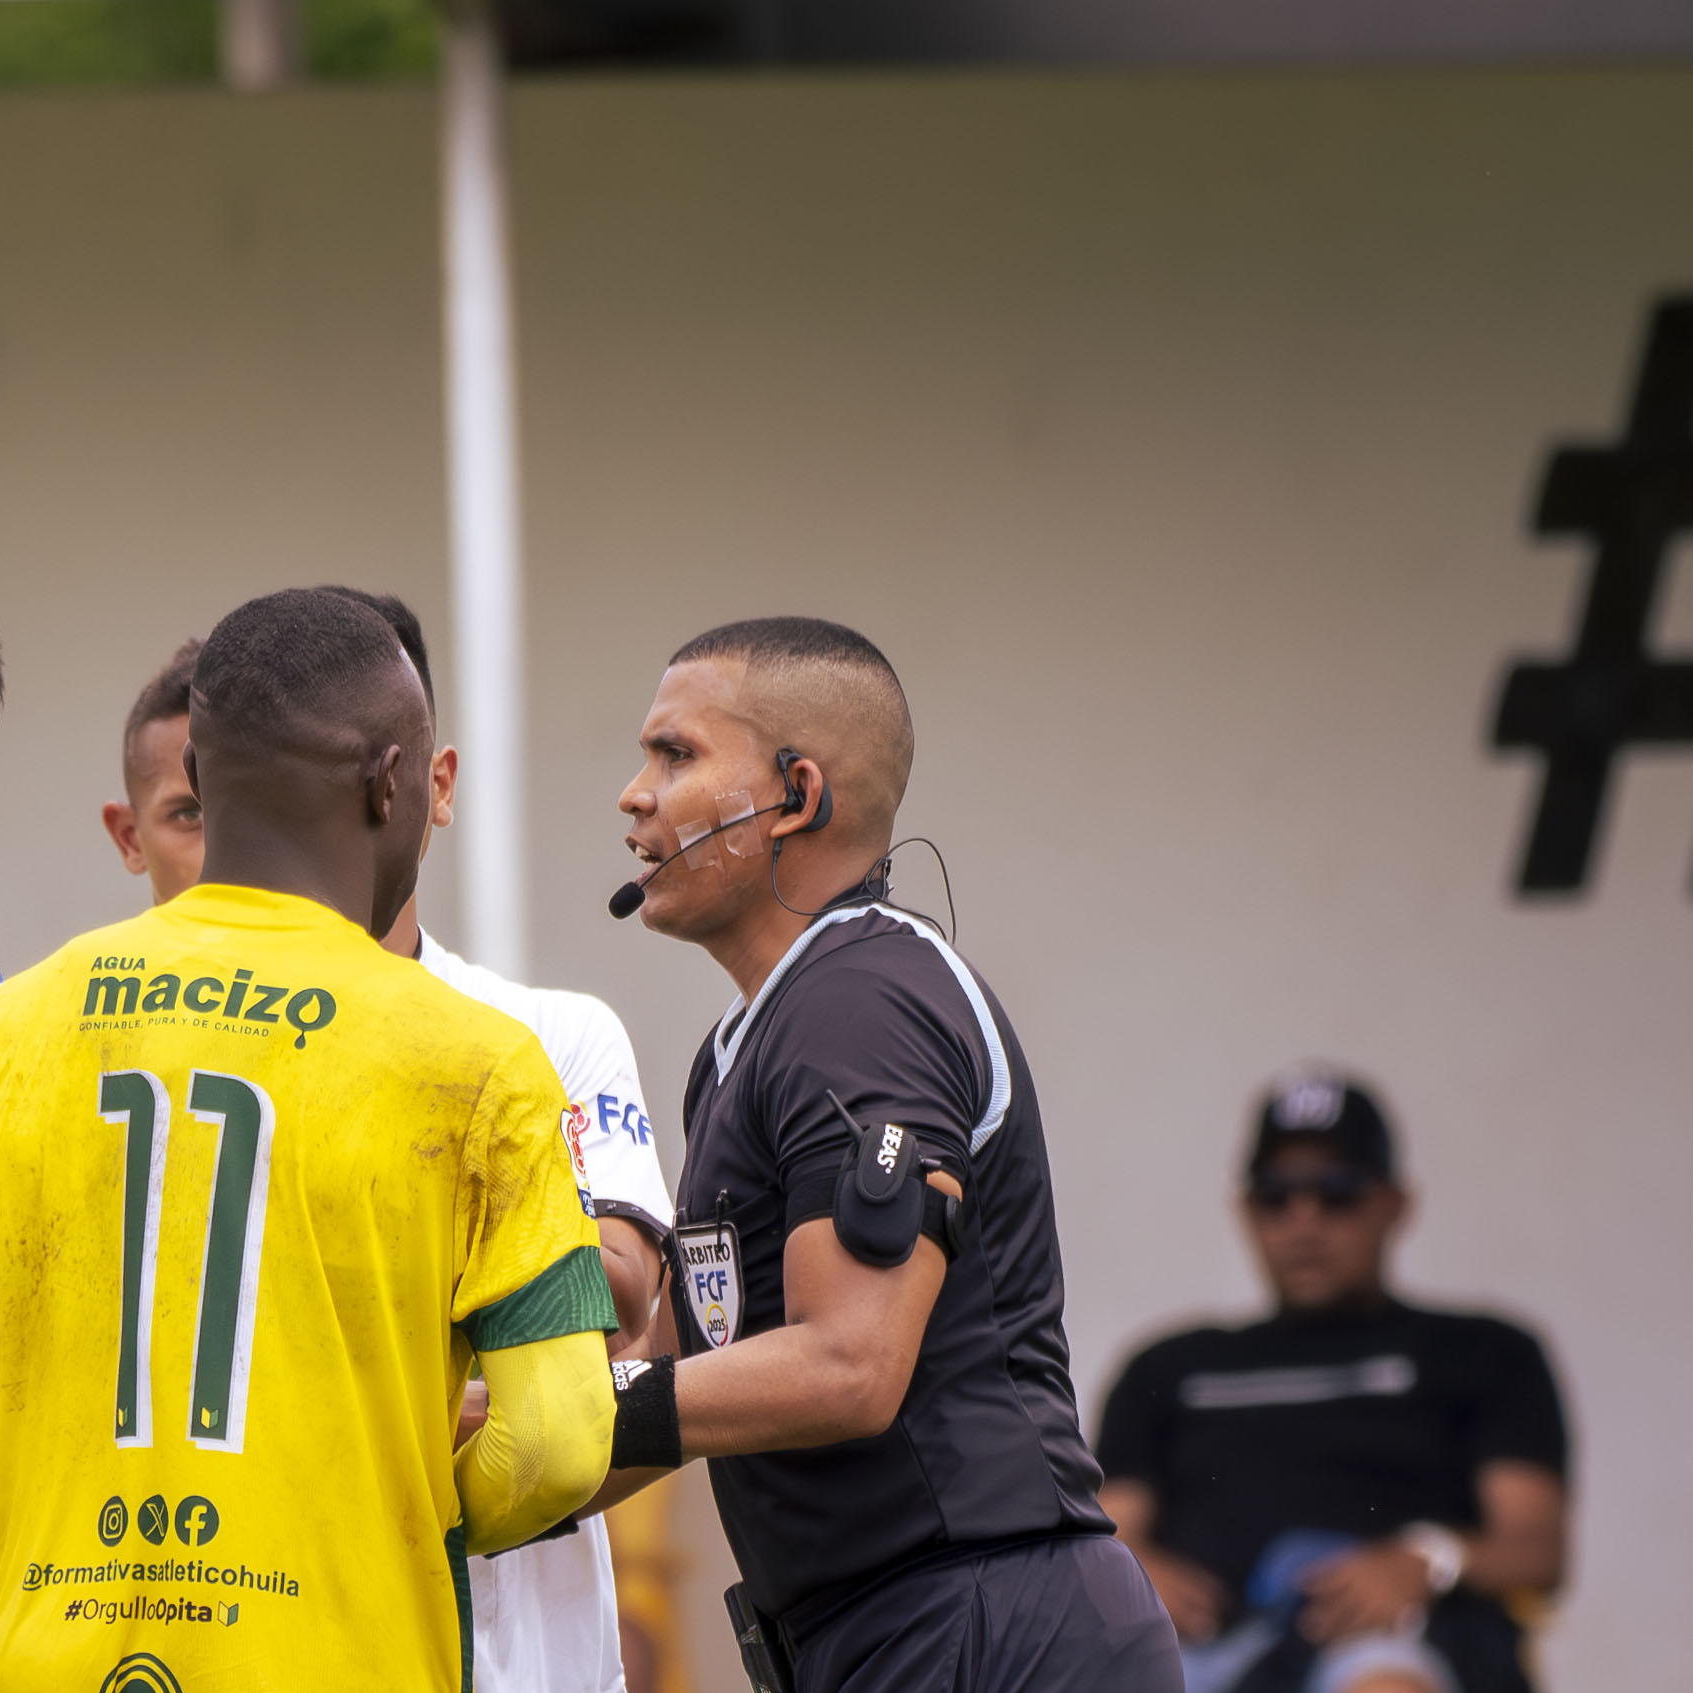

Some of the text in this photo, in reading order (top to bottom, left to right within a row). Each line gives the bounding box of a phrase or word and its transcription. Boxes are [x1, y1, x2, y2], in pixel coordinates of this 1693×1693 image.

[90, 956, 146, 972] AGUA
[82, 968, 337, 1050] macizo
[79, 1017, 270, 1037] CONFIABLE, PURA Y DE CALIDAD
[97, 1069, 276, 1454] 11
[694, 1269, 728, 1304] FCF
[709, 1318, 726, 1333] 2025
[22, 1558, 300, 1598] @formativasatleticohuila
[64, 1596, 213, 1626] #OrgulloOpita
